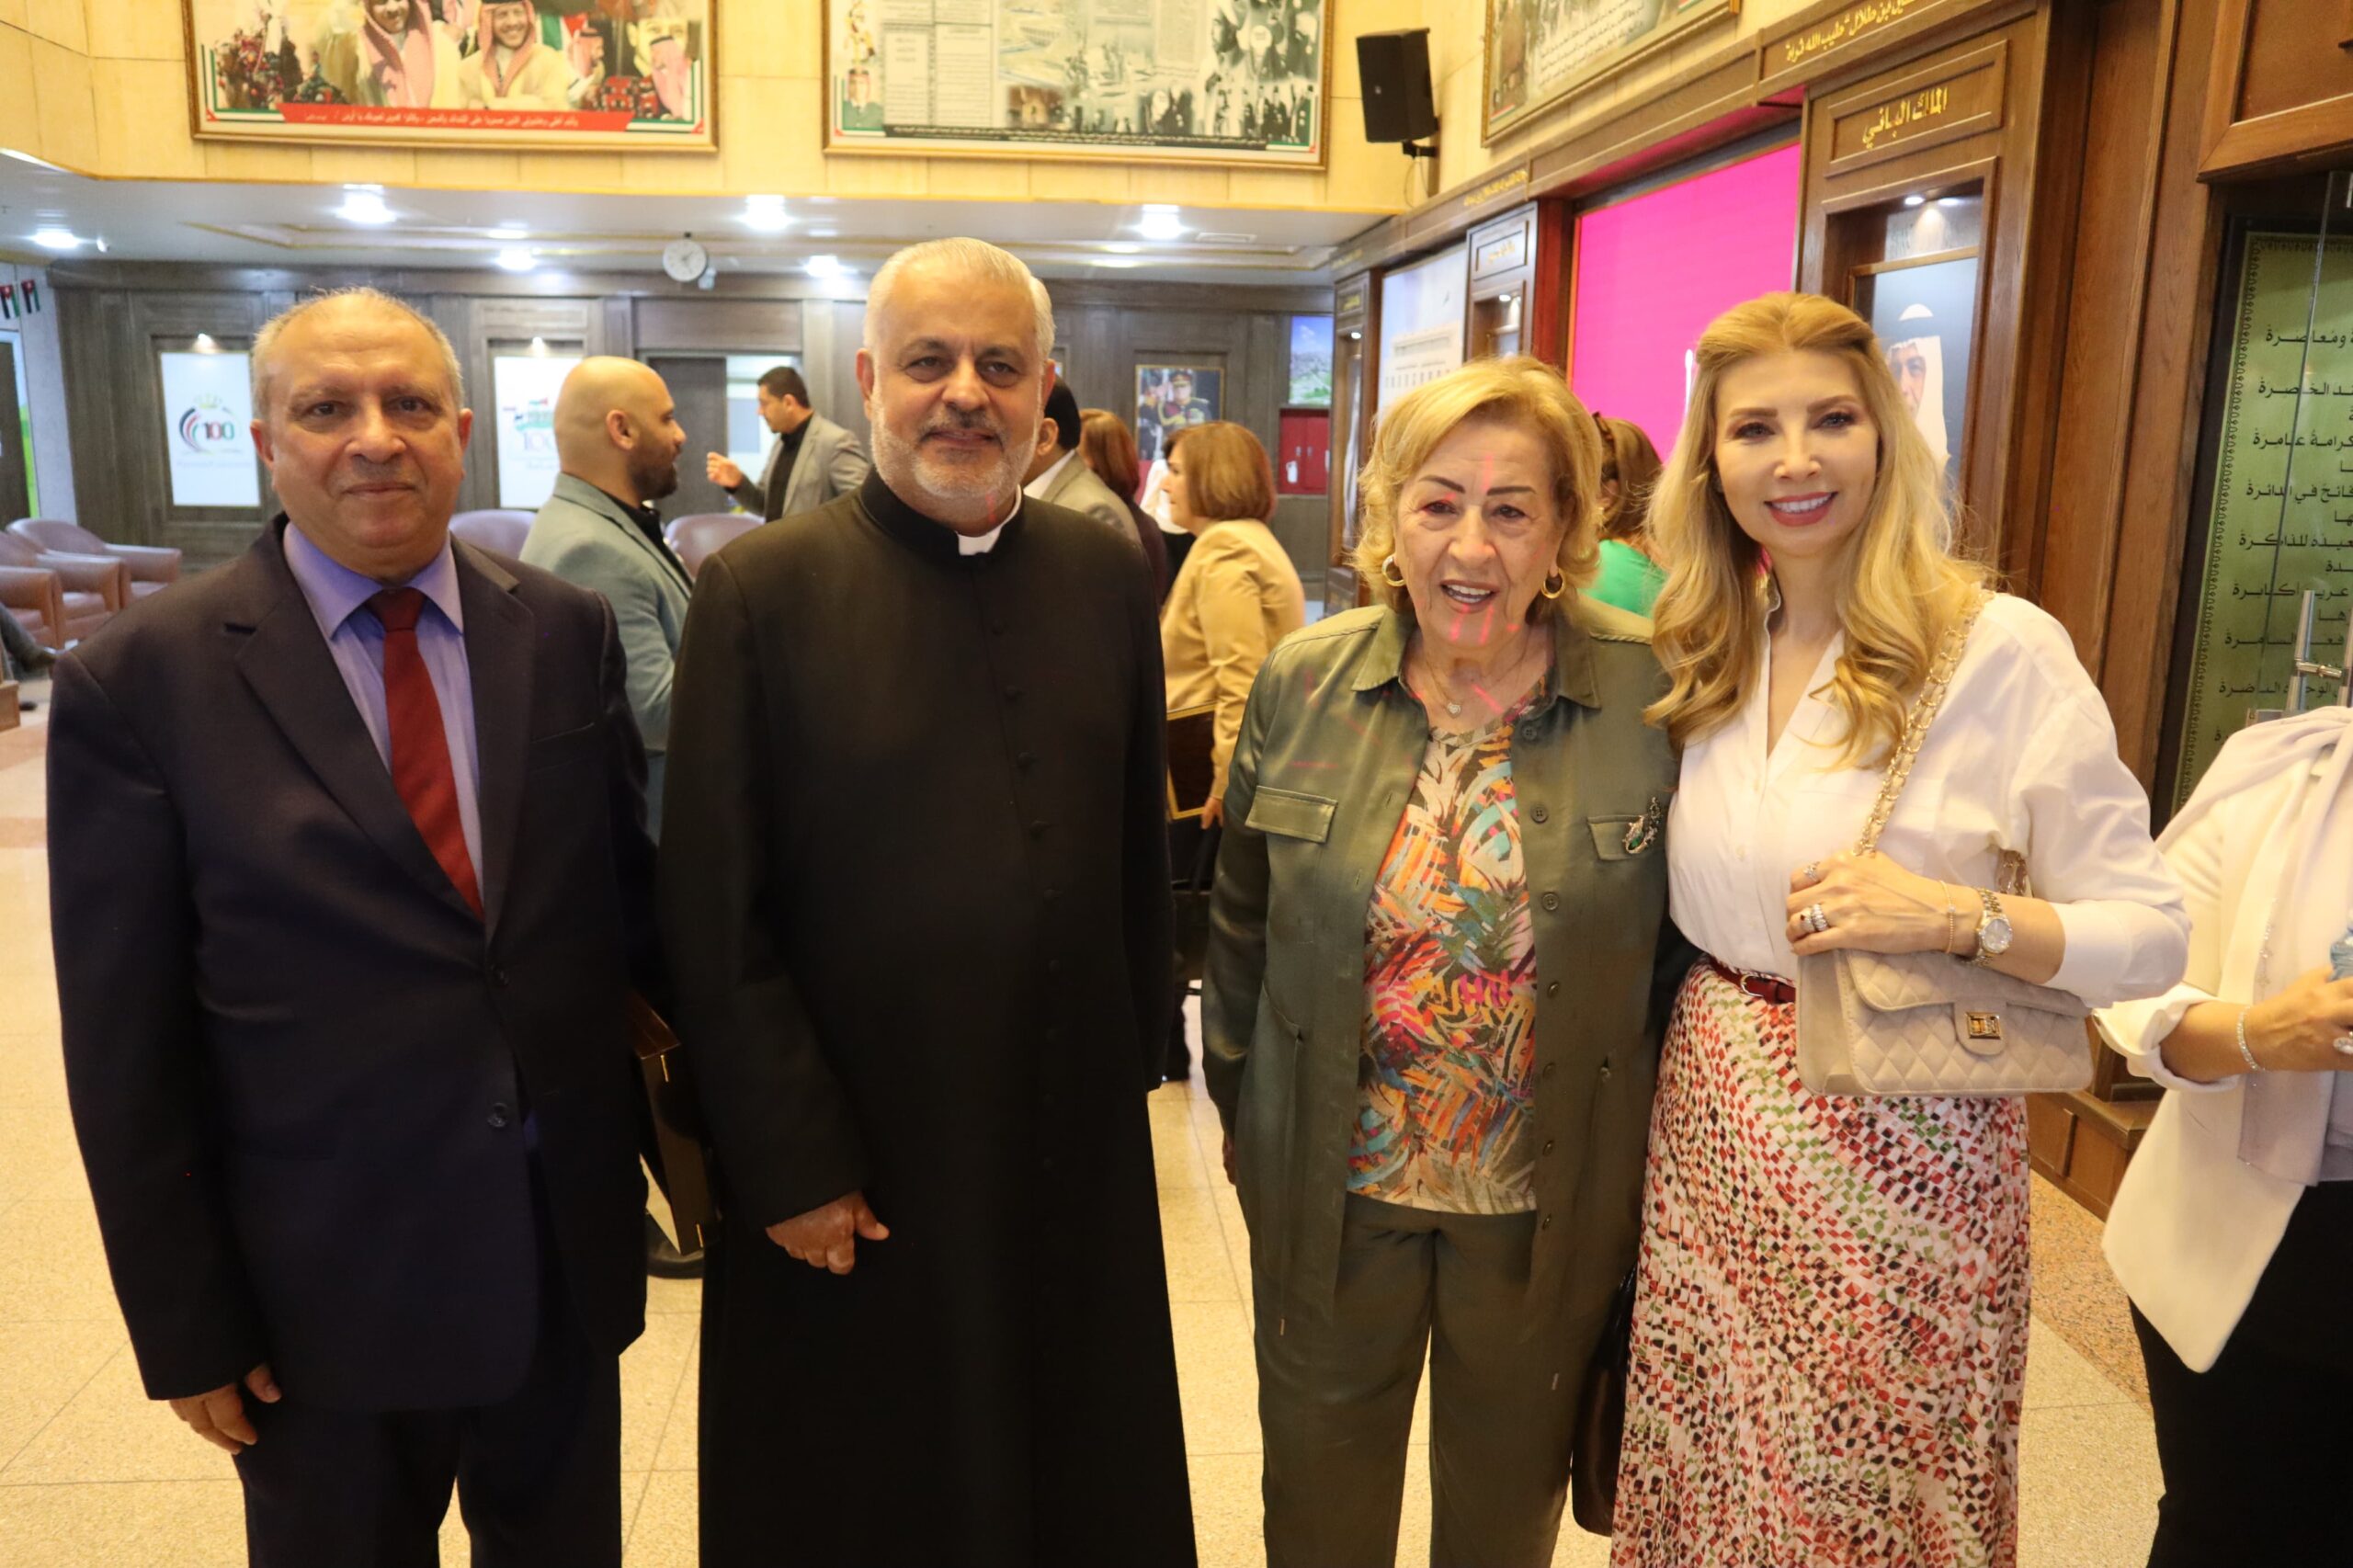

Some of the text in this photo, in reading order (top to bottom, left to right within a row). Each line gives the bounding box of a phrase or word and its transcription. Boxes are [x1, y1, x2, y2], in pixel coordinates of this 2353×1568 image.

[1862, 85, 1949, 150] الملك الباني
[2258, 378, 2329, 398] الخصرة
[203, 421, 235, 440] 100
[2295, 484, 2317, 504] في
